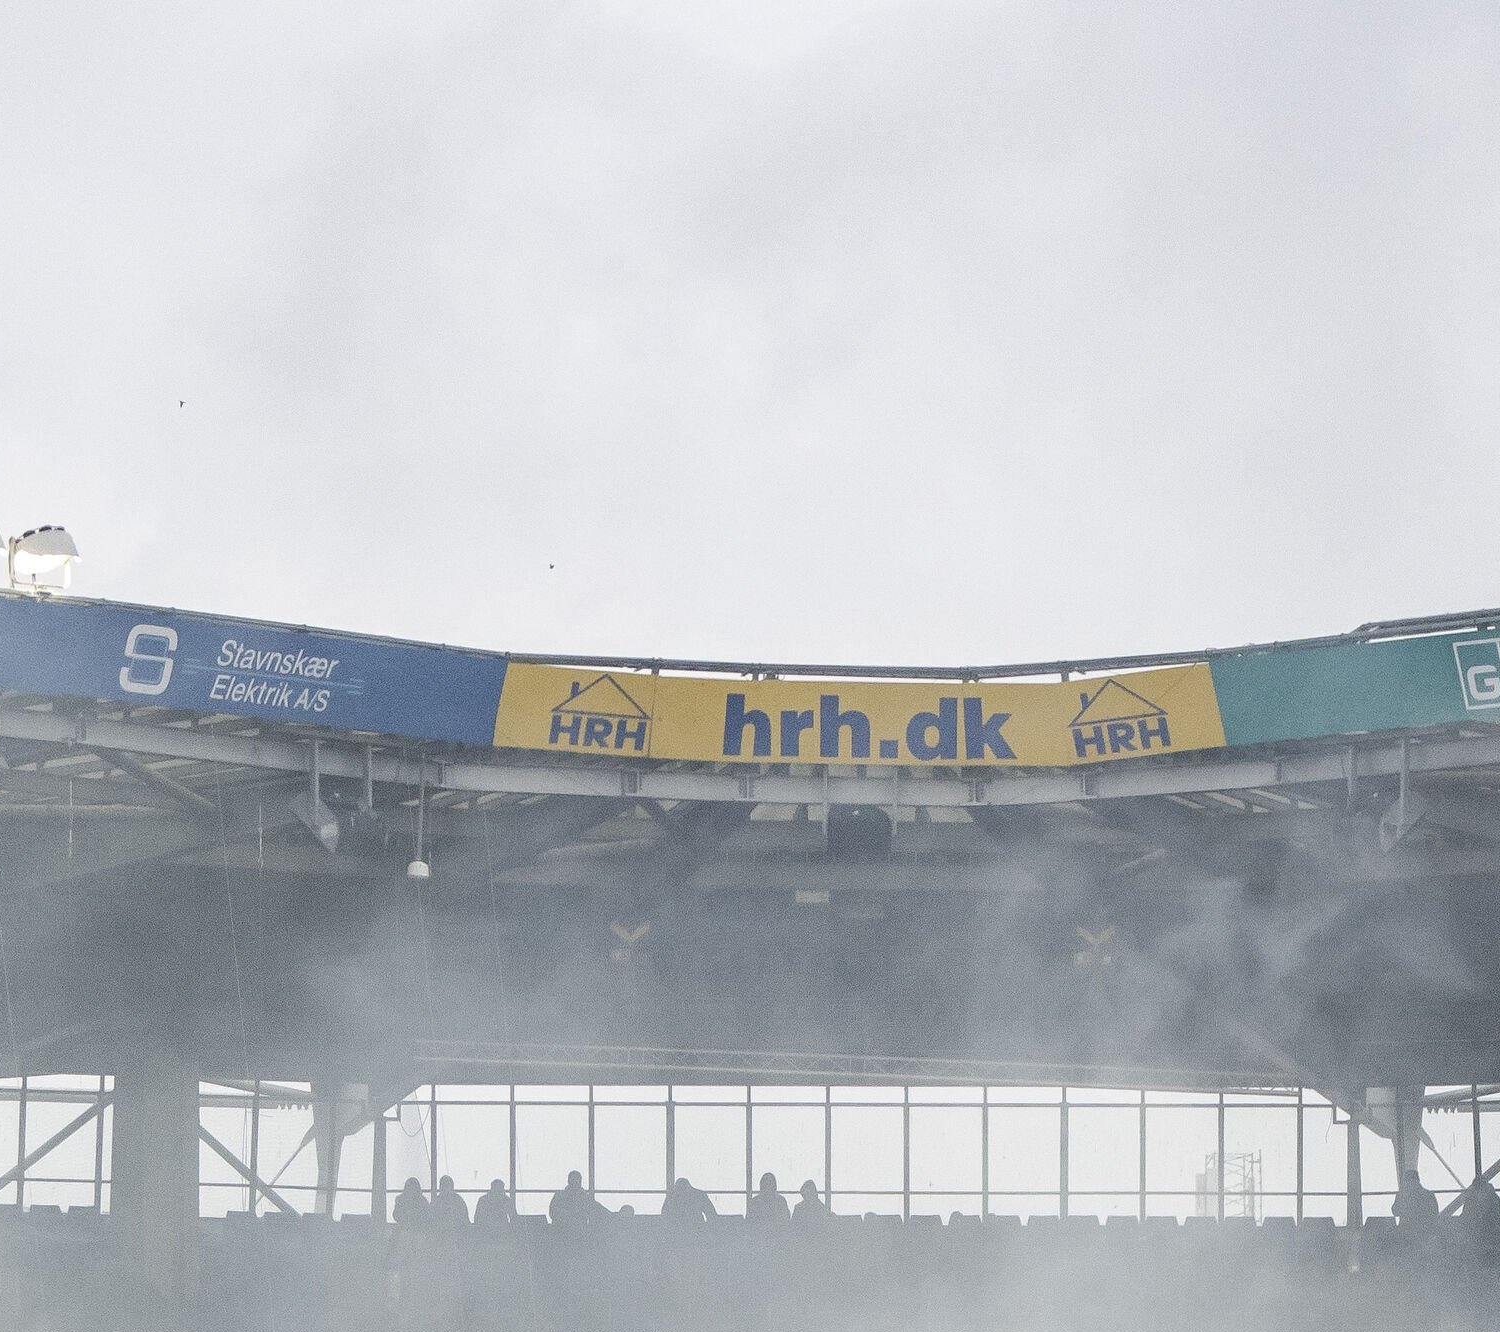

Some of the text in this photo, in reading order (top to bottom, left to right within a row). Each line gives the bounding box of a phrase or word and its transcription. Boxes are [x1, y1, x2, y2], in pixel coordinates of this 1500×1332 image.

[216, 639, 339, 680] Stavnskær
[209, 673, 330, 713] Elektrik A/S
[548, 714, 648, 751] HRH
[723, 693, 1017, 760] hrh.dk
[1072, 716, 1171, 758] HRH
